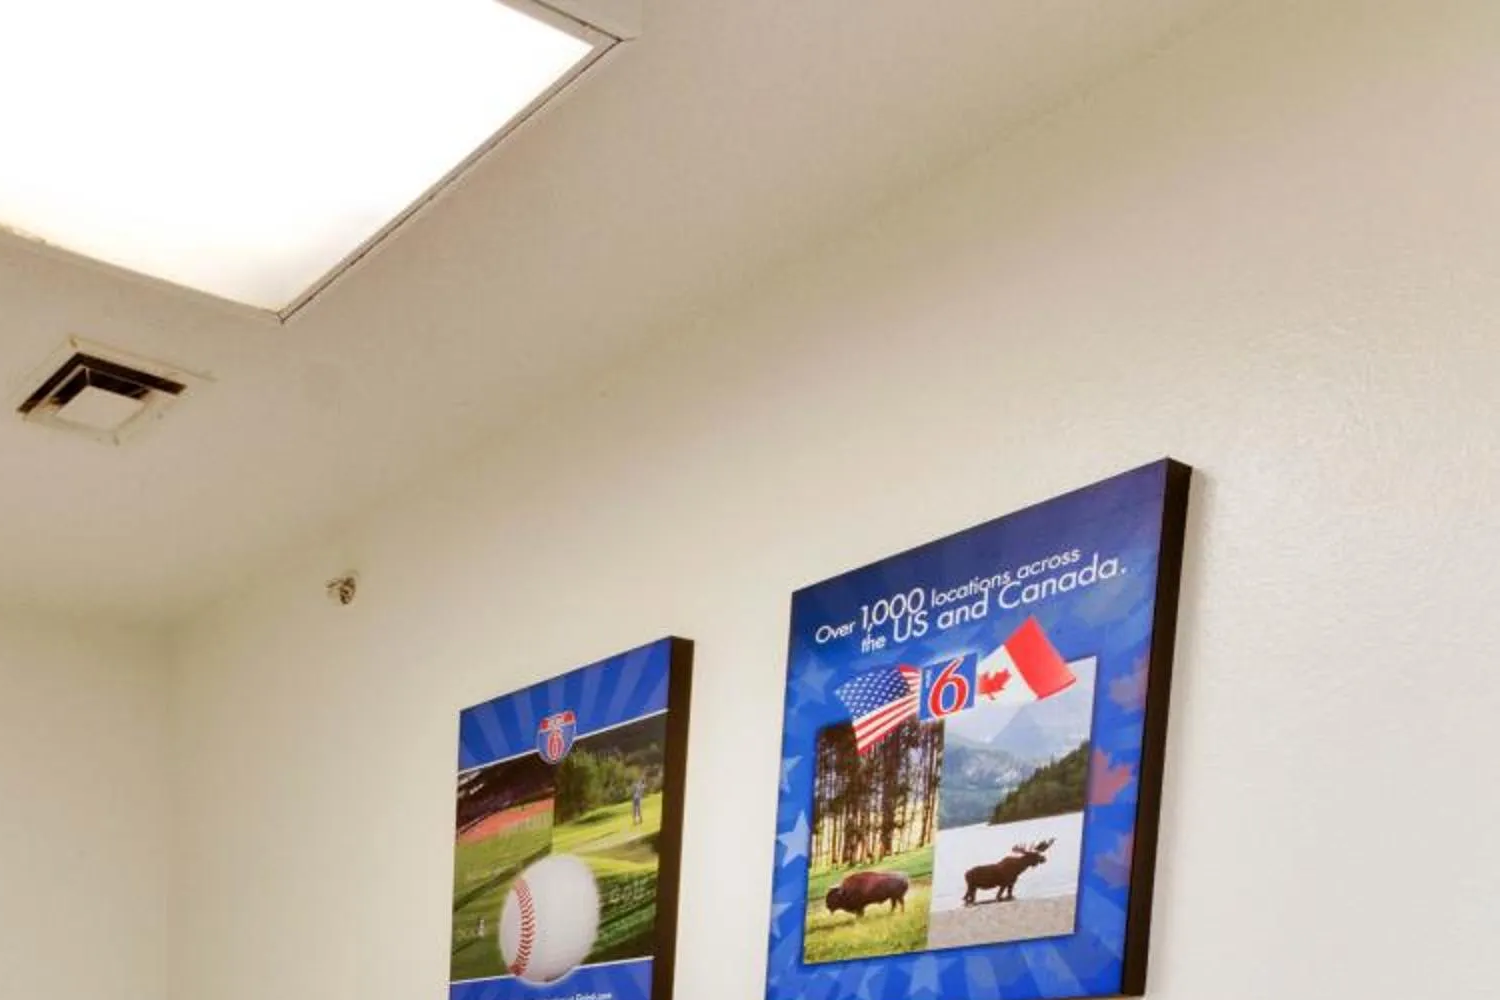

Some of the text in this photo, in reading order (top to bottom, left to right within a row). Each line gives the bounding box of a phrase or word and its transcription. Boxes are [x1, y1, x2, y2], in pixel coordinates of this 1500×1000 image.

[815, 620, 855, 643] Over
[931, 571, 1011, 608] locations
[1017, 548, 1081, 579] across
[861, 552, 1127, 653] the US and Canada.
[928, 656, 969, 719] 6
